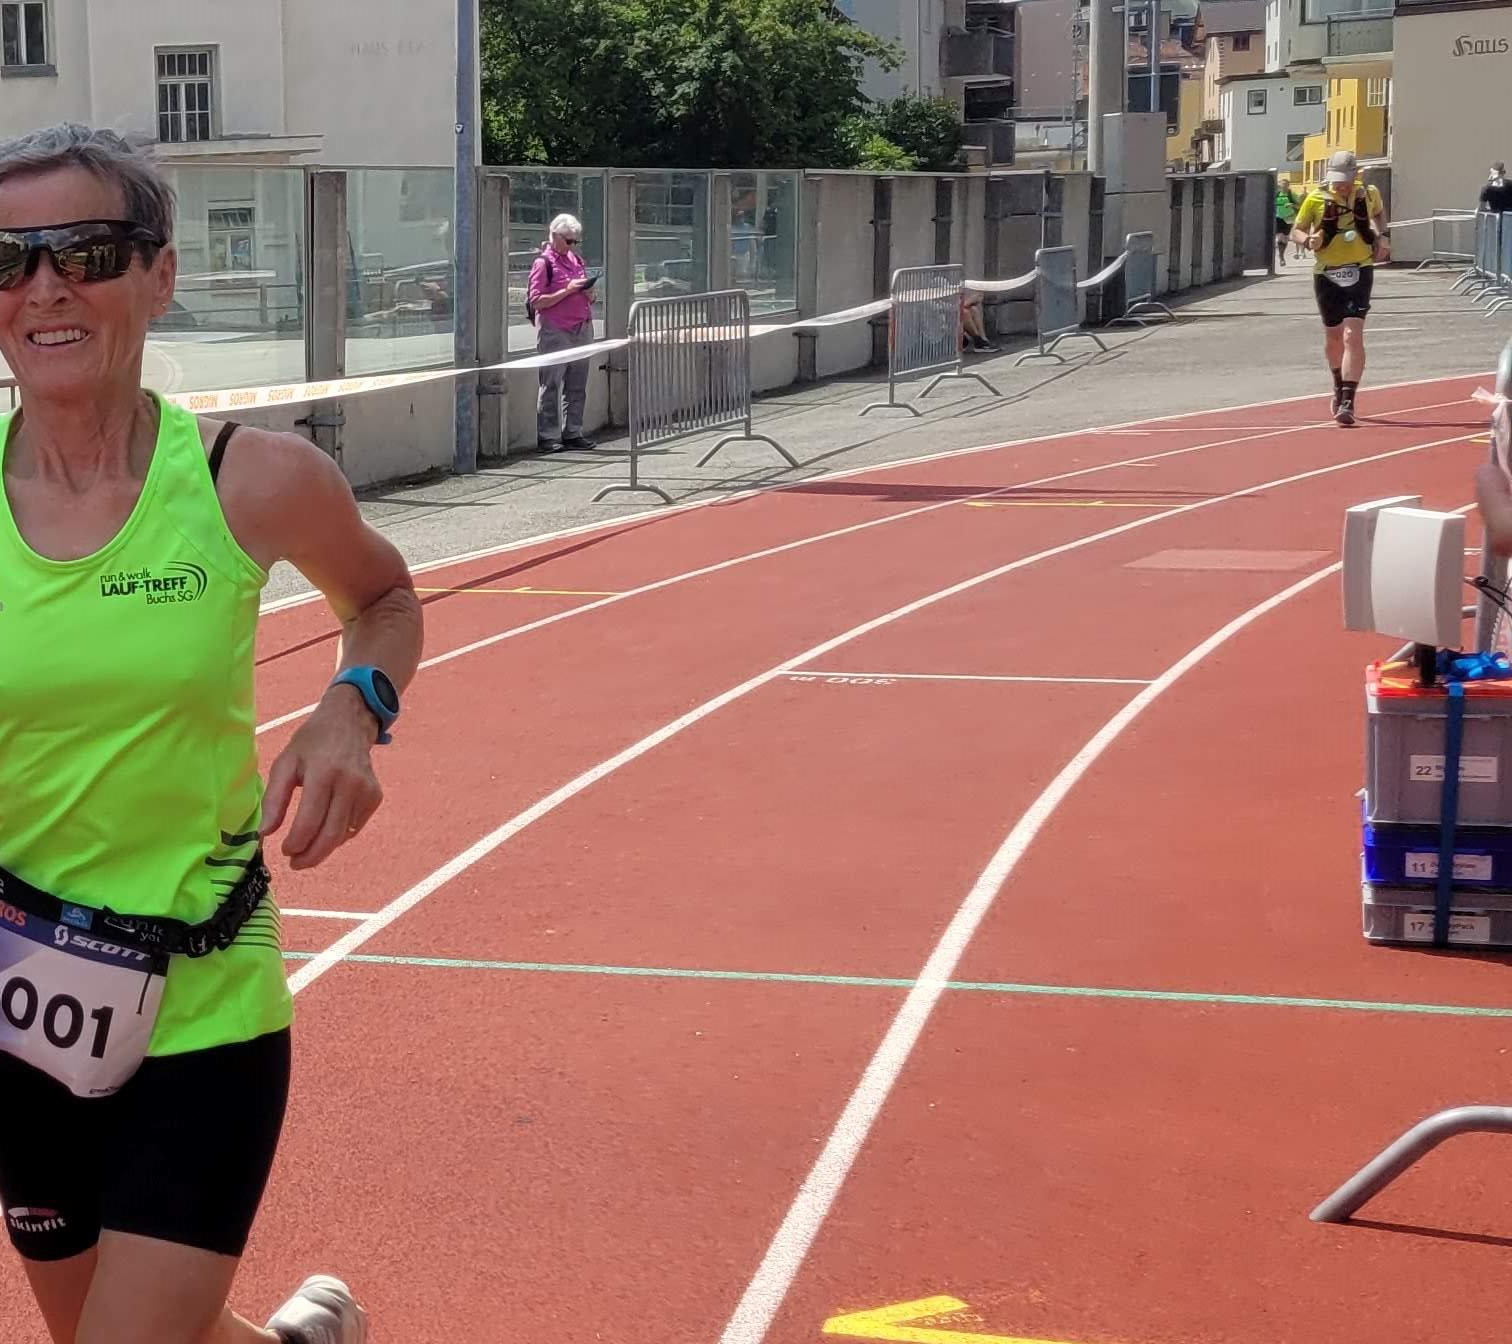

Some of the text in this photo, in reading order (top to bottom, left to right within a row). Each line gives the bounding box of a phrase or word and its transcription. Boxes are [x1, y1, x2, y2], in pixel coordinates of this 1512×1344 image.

[1453, 35, 1509, 57] Haus
[100, 574, 117, 584] run
[101, 575, 188, 598] LAUF-TREFF
[145, 589, 194, 605] Buchs SG
[1415, 765, 1433, 776] 22
[1412, 862, 1426, 873] 11
[1411, 921, 1426, 932] 17
[70, 935, 151, 961] SCOTT
